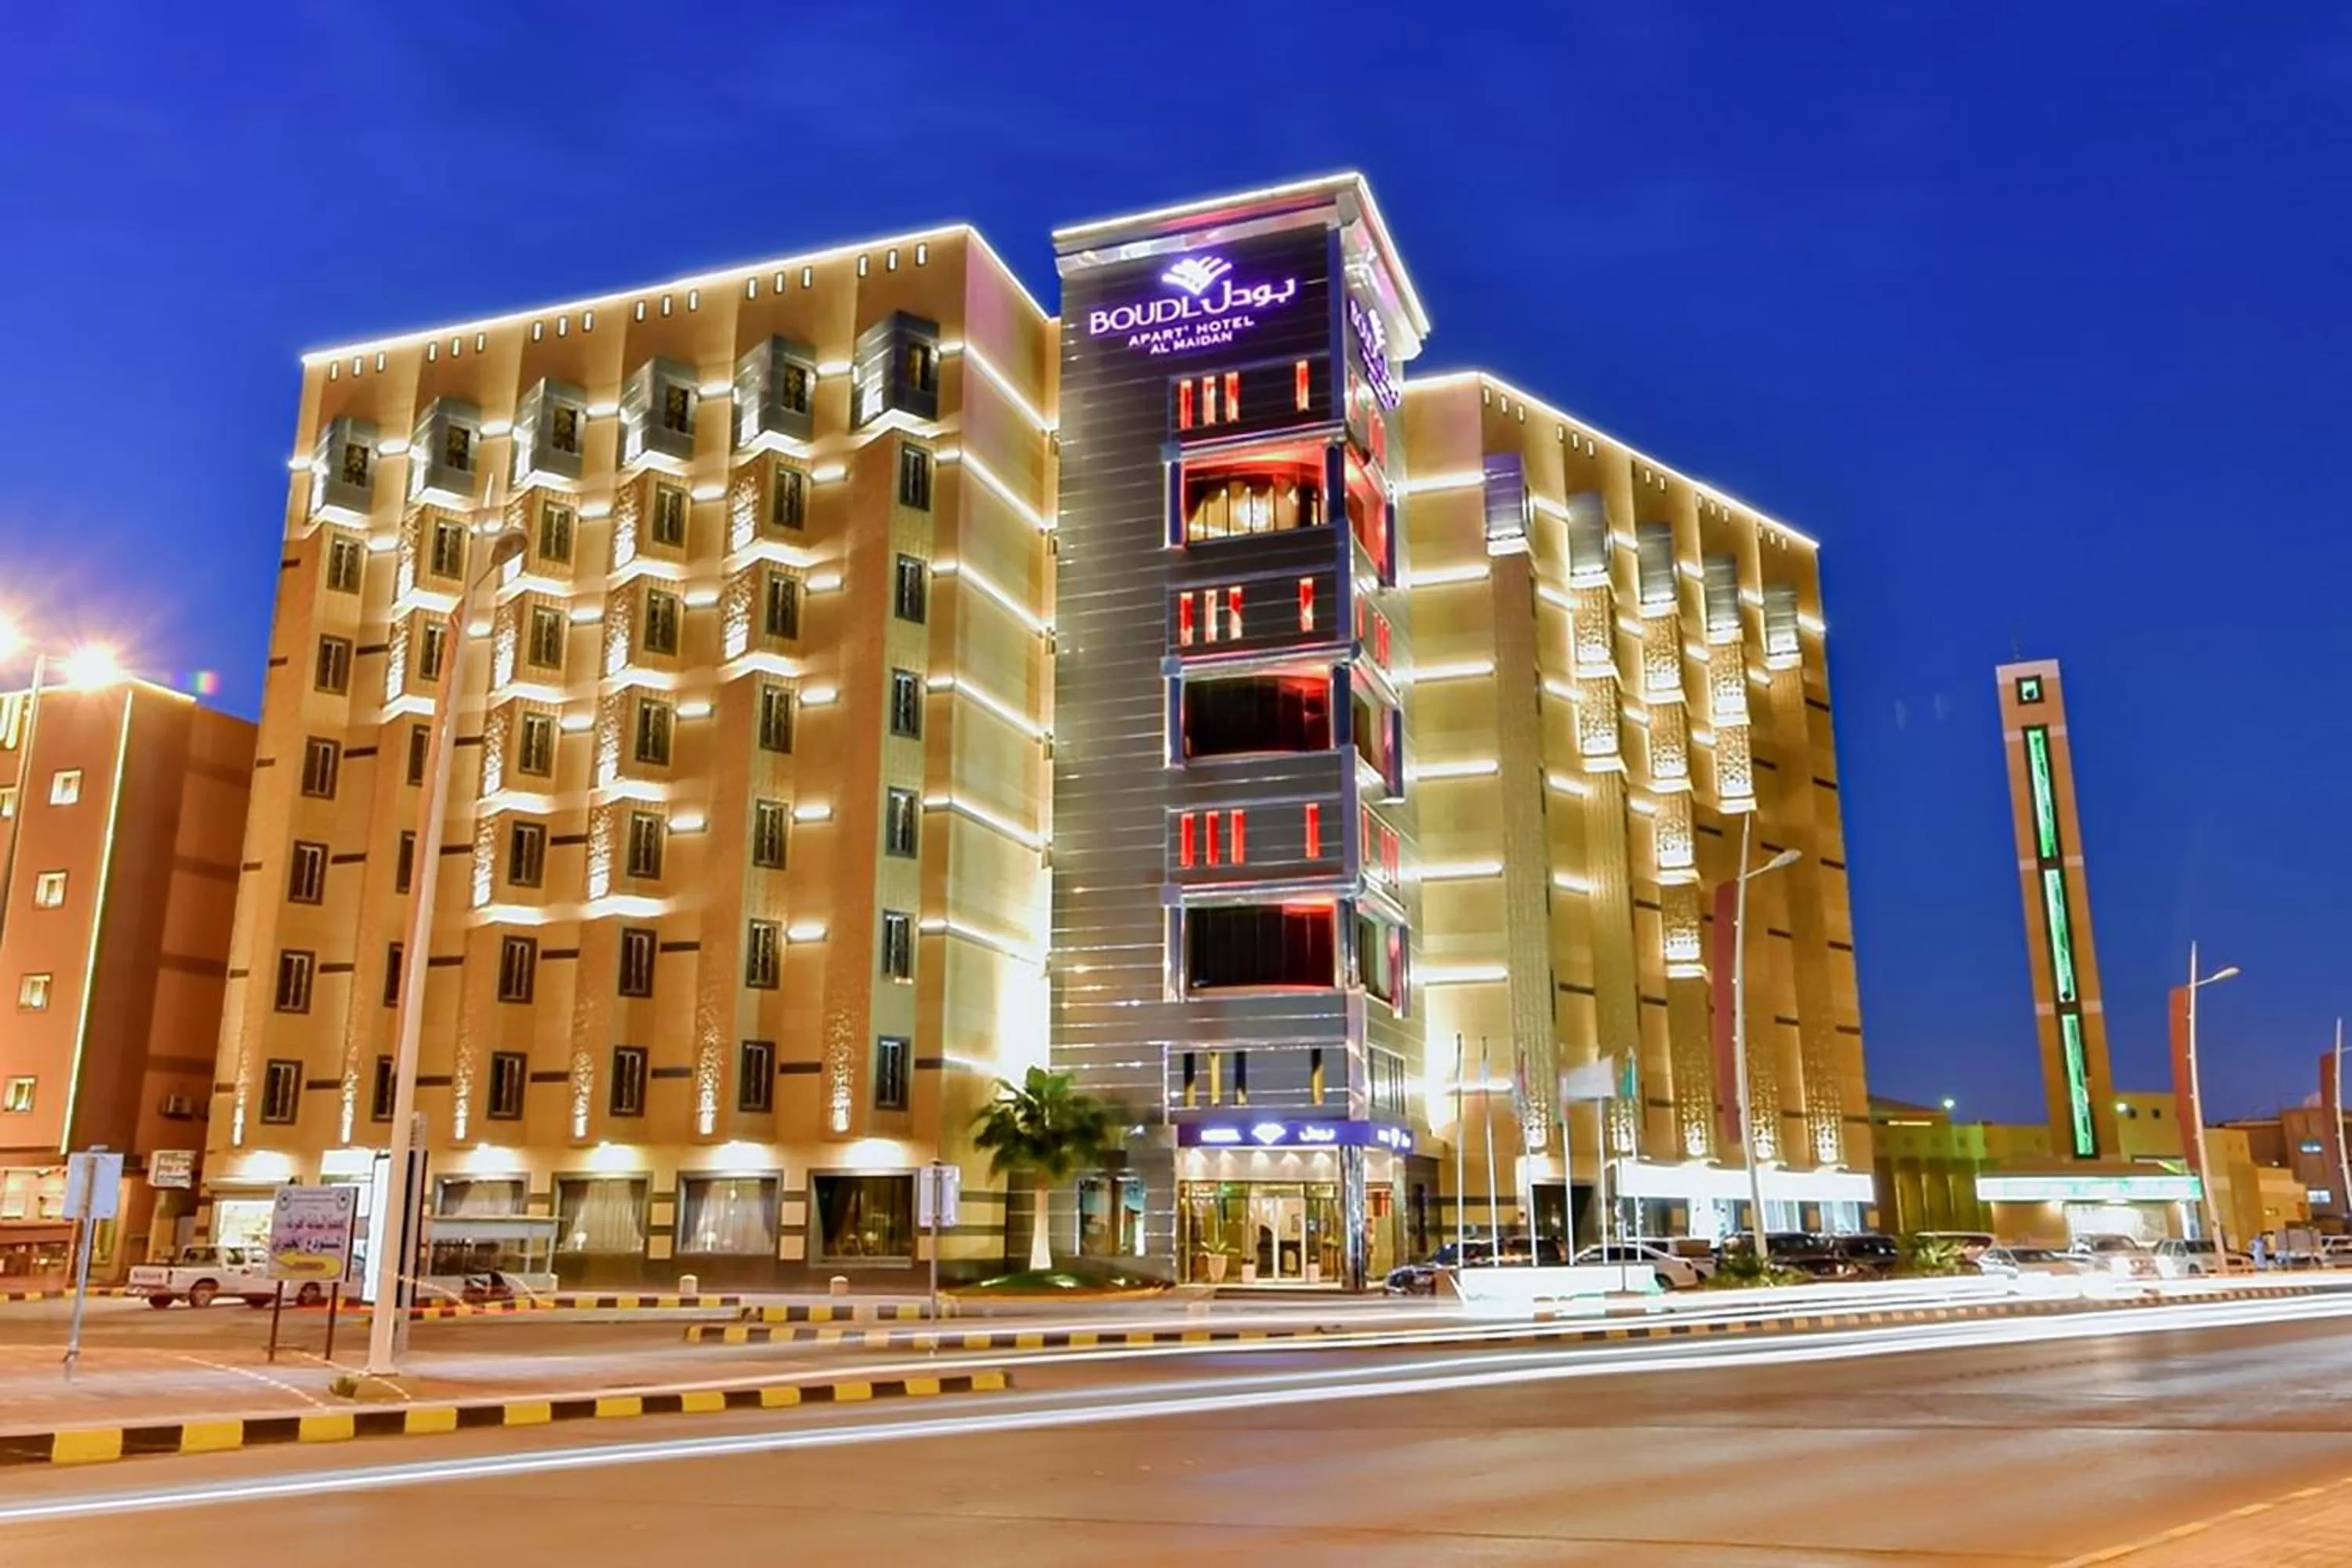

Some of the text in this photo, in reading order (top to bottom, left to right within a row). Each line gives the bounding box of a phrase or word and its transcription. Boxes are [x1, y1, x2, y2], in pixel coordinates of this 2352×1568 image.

[1200, 278, 1295, 314] بودل
[1091, 296, 1202, 335] BOUDL
[1196, 315, 1255, 334] HOTEL
[1150, 331, 1233, 354] AL MAIDAN
